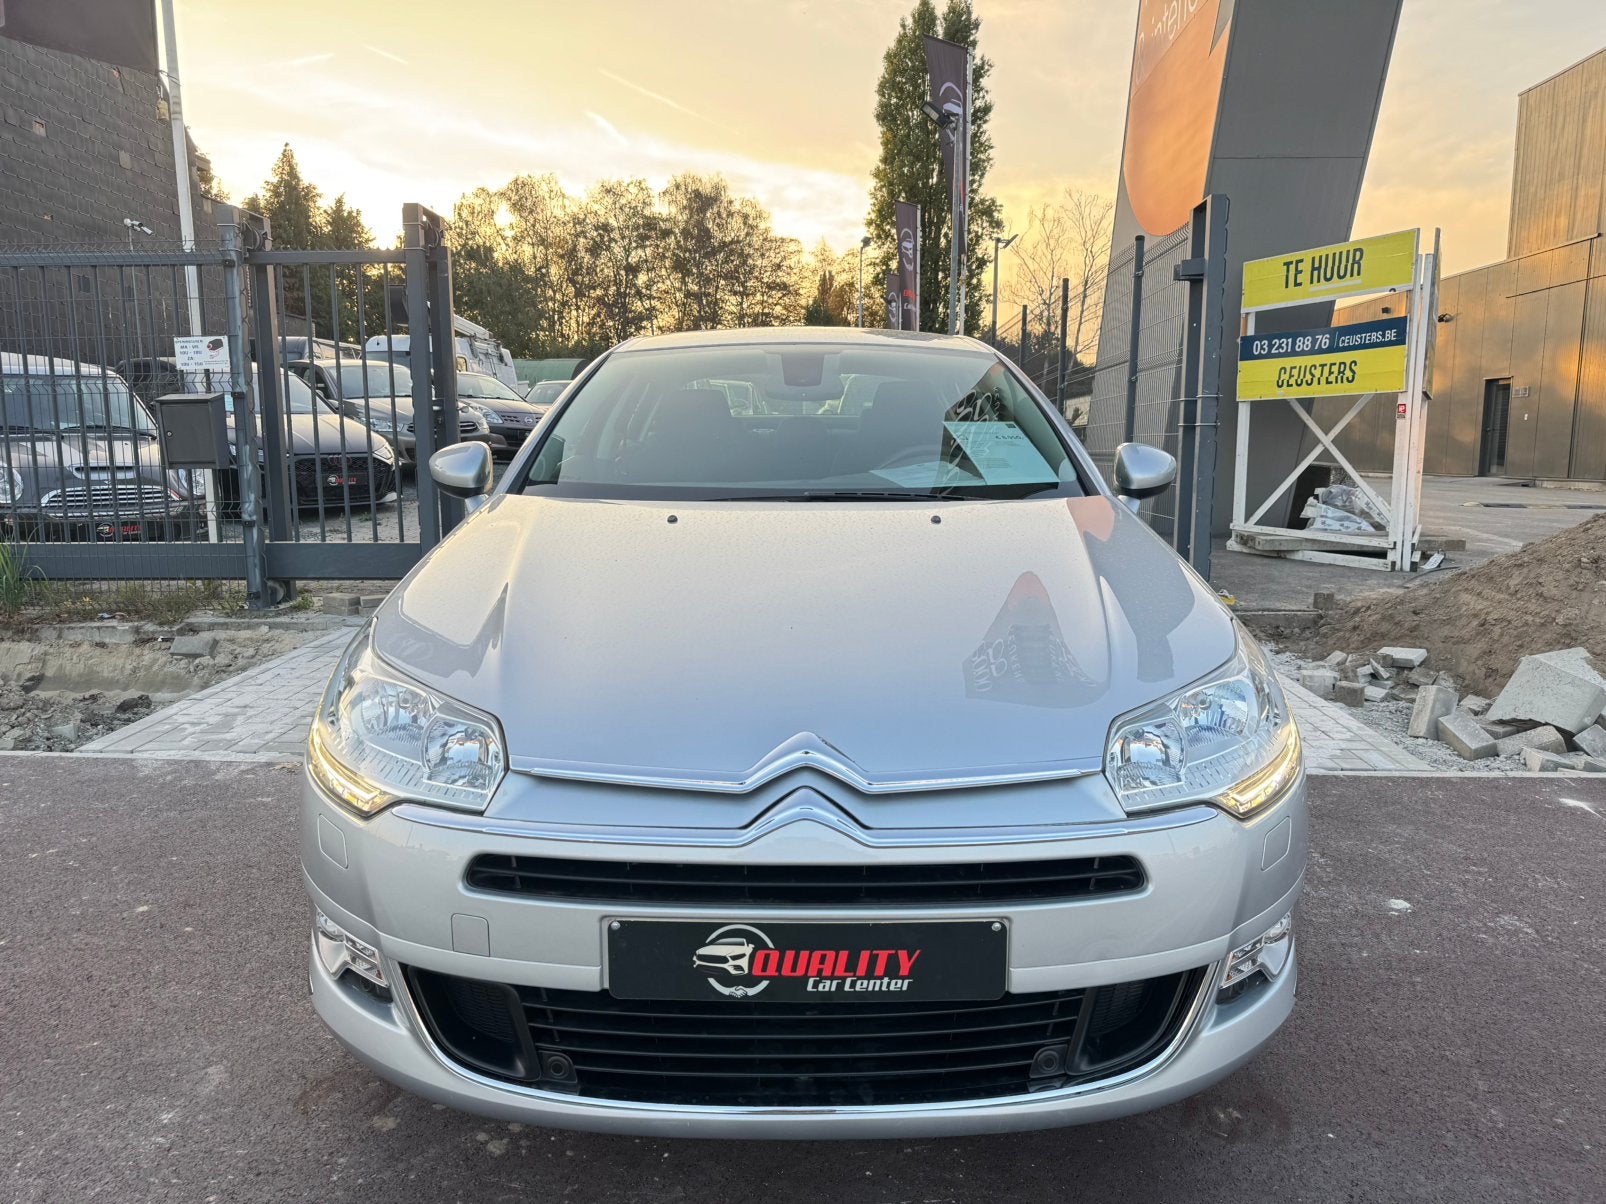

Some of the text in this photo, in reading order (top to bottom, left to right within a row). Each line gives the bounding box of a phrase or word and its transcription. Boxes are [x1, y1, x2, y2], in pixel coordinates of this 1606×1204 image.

[1283, 247, 1364, 289] TE HUUR
[1253, 329, 1397, 355] 03 231 88 76 CEUSTERS.BE
[1277, 359, 1358, 388] CEUSTERS
[752, 949, 921, 977] QUALITY
[807, 977, 913, 992] Car Center
